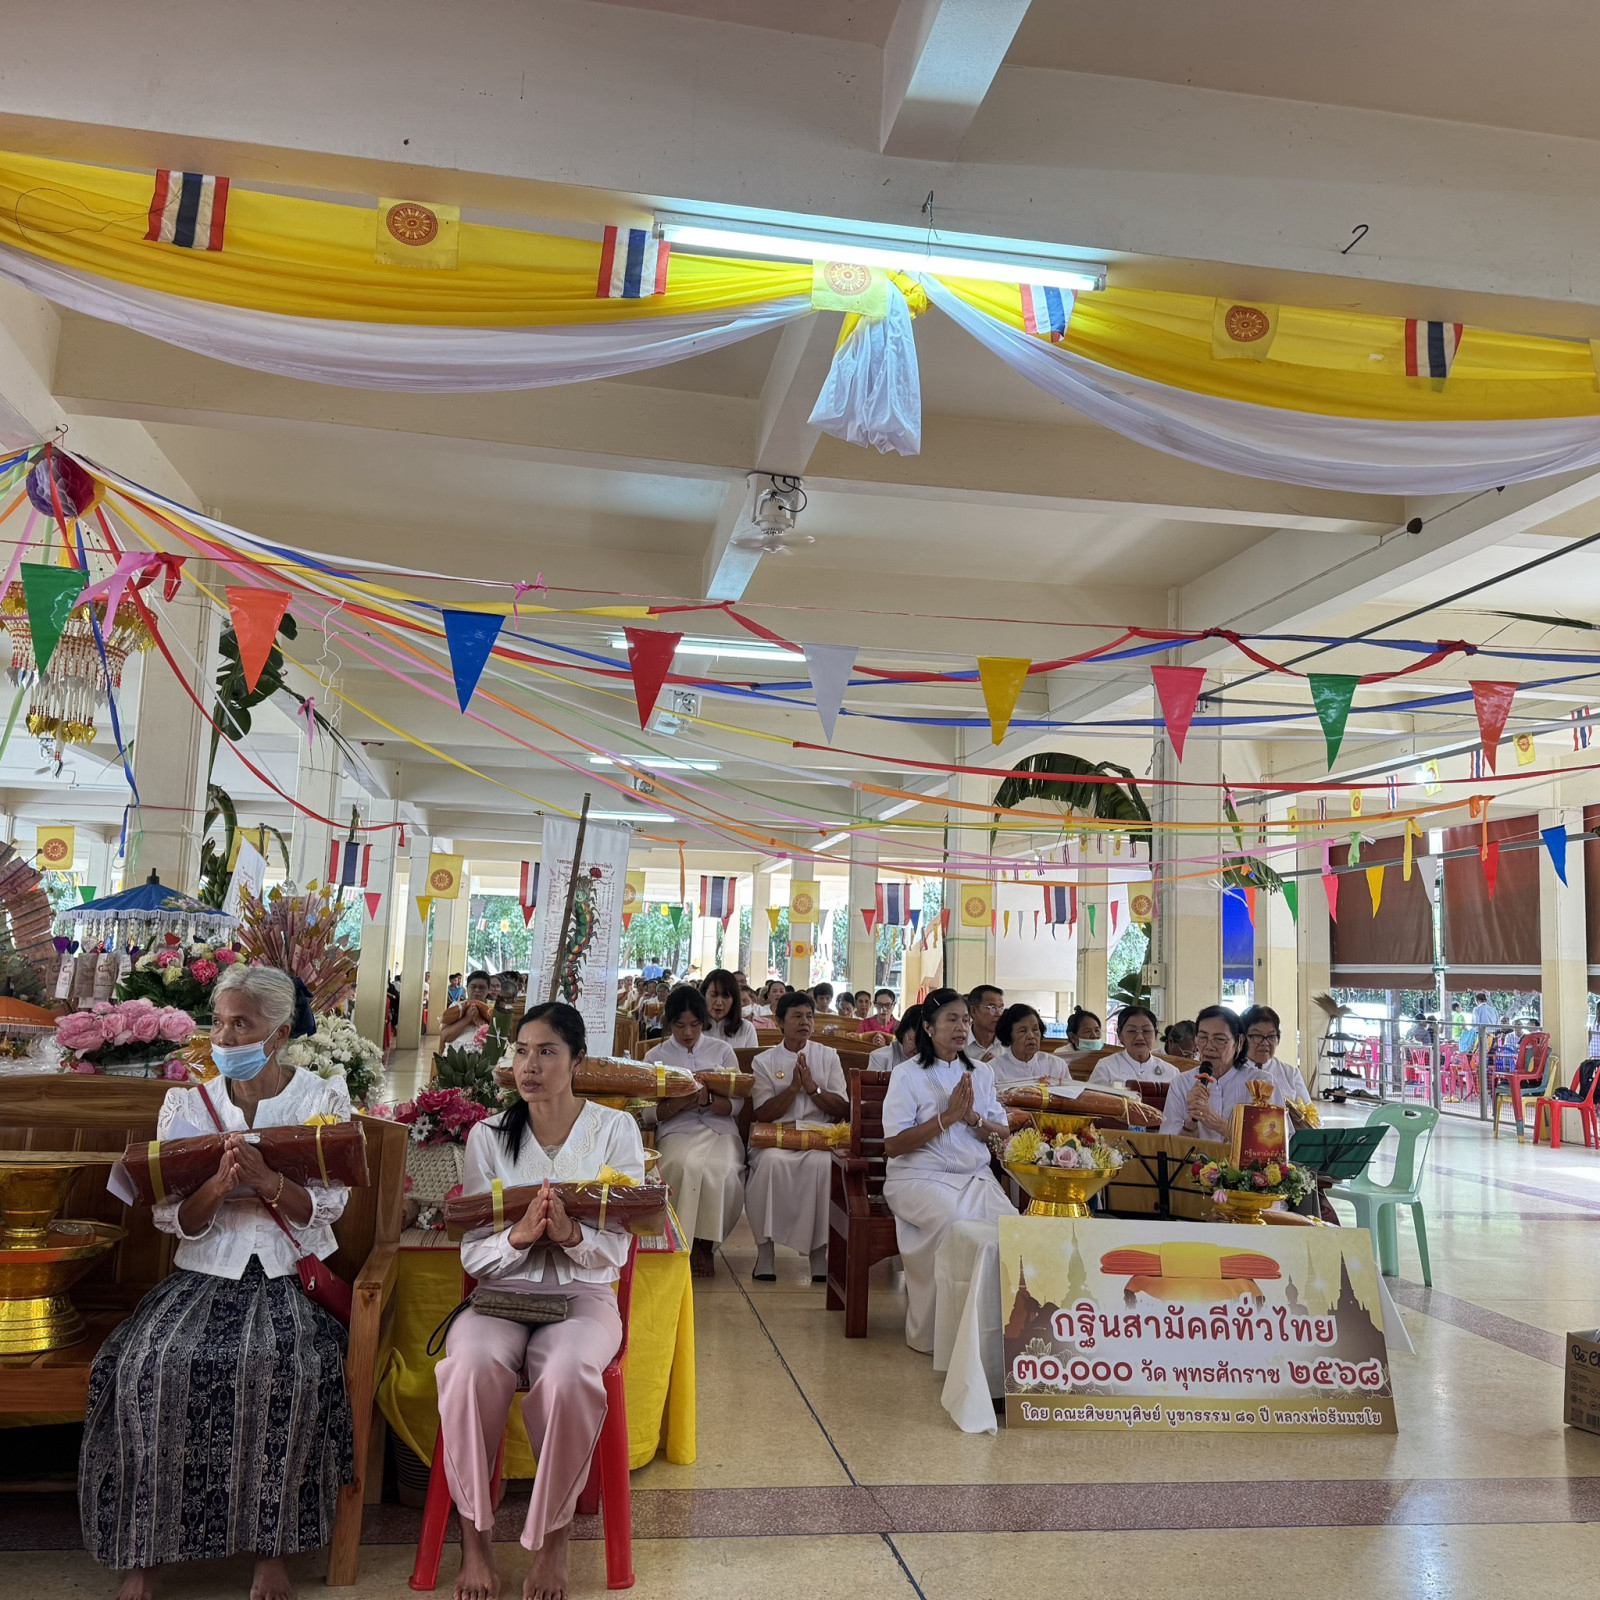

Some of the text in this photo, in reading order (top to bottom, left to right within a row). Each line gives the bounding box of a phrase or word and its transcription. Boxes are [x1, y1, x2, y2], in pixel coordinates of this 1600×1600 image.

[1055, 1297, 1334, 1347] กฐินสามัคคีทั่วไทย
[1017, 1357, 1380, 1390] ๓๐,๐๐๐ วัด พุทธศักราช ๒๕๖๘
[1022, 1404, 1381, 1426] โดย คณะศิษยานุศิษย์ บูชาธรรม ๘๑ ปี หลวงพ่อธัมมชโย
